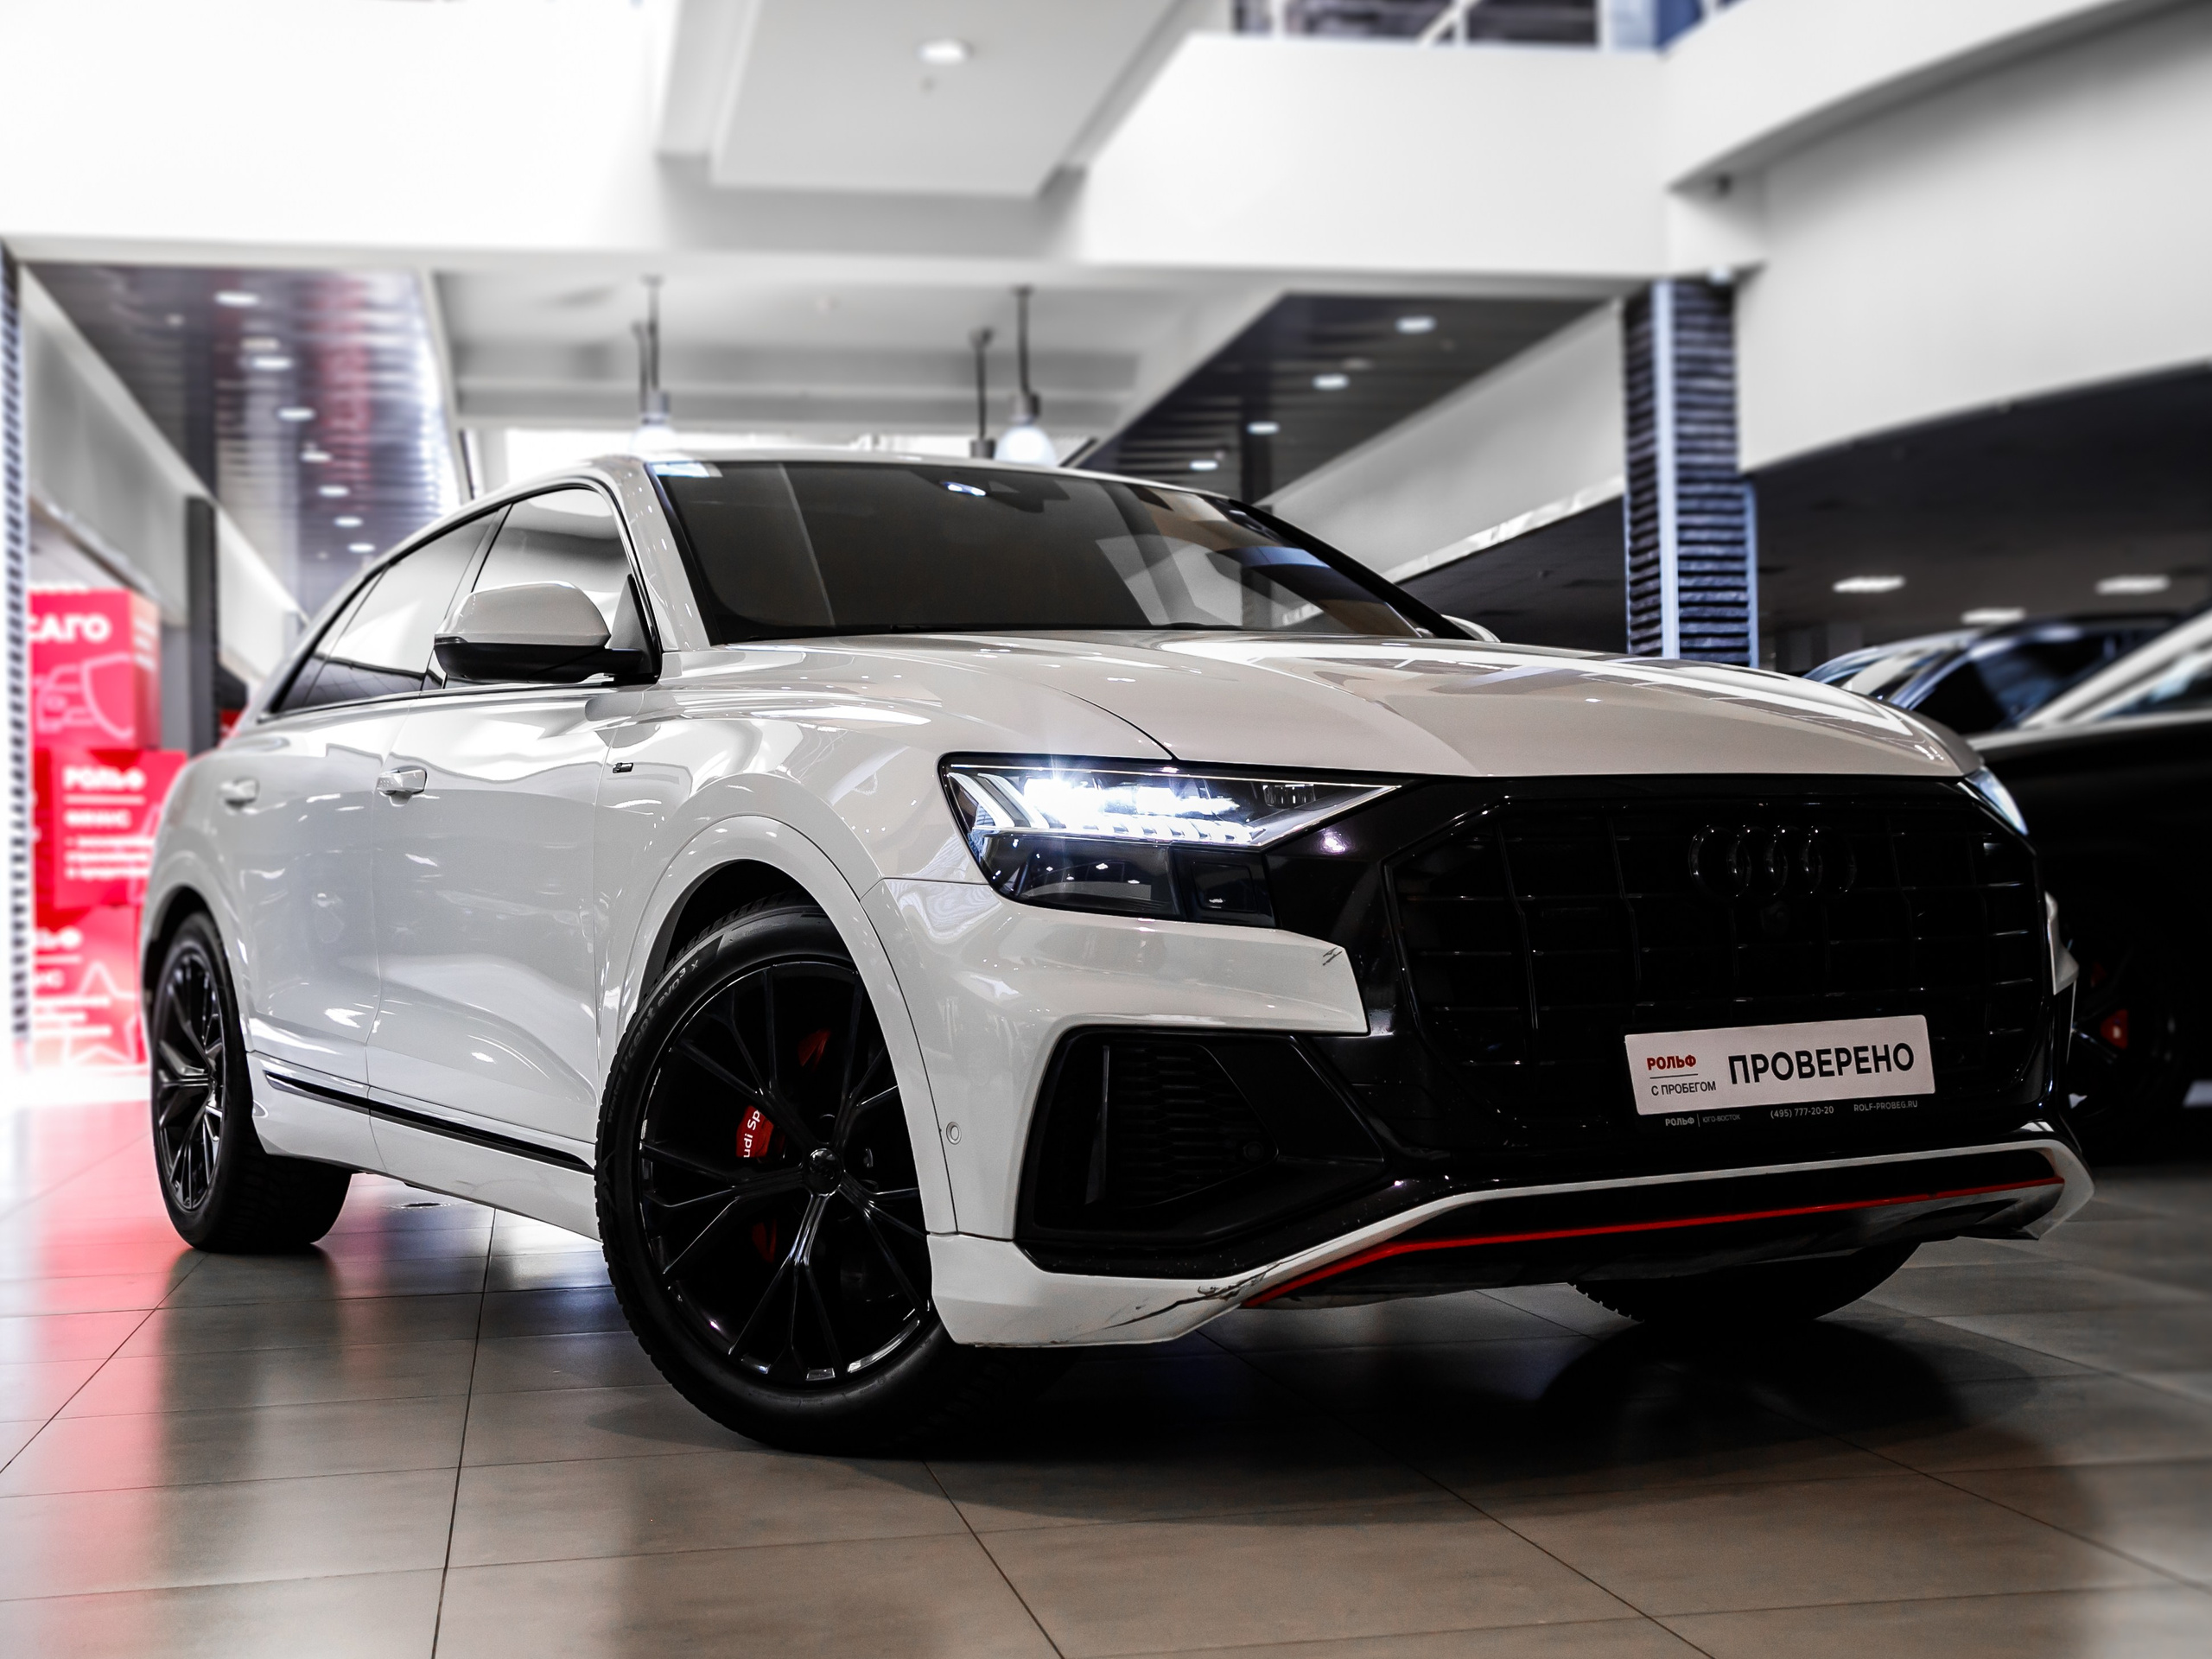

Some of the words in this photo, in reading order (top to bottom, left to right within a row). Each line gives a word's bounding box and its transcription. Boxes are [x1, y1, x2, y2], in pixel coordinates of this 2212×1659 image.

[1647, 1055, 1697, 1071] РОЛЬФ
[1728, 1042, 1915, 1084] ПРОВЕРЕНО
[1651, 1085, 1659, 1096] С
[1661, 1081, 1716, 1096] ПРОБЕГОМ
[1770, 1109, 1793, 1119] (495)
[1794, 1105, 1834, 1116] 777-20-20
[1853, 1100, 1918, 1112] ROLF-PROBEG.RU
[747, 1109, 760, 1131] Sp
[1665, 1116, 1695, 1127] РОЛЬФ
[1702, 1114, 1741, 1123] ЮГО-ВОСТОК
[743, 1133, 753, 1158] udi
